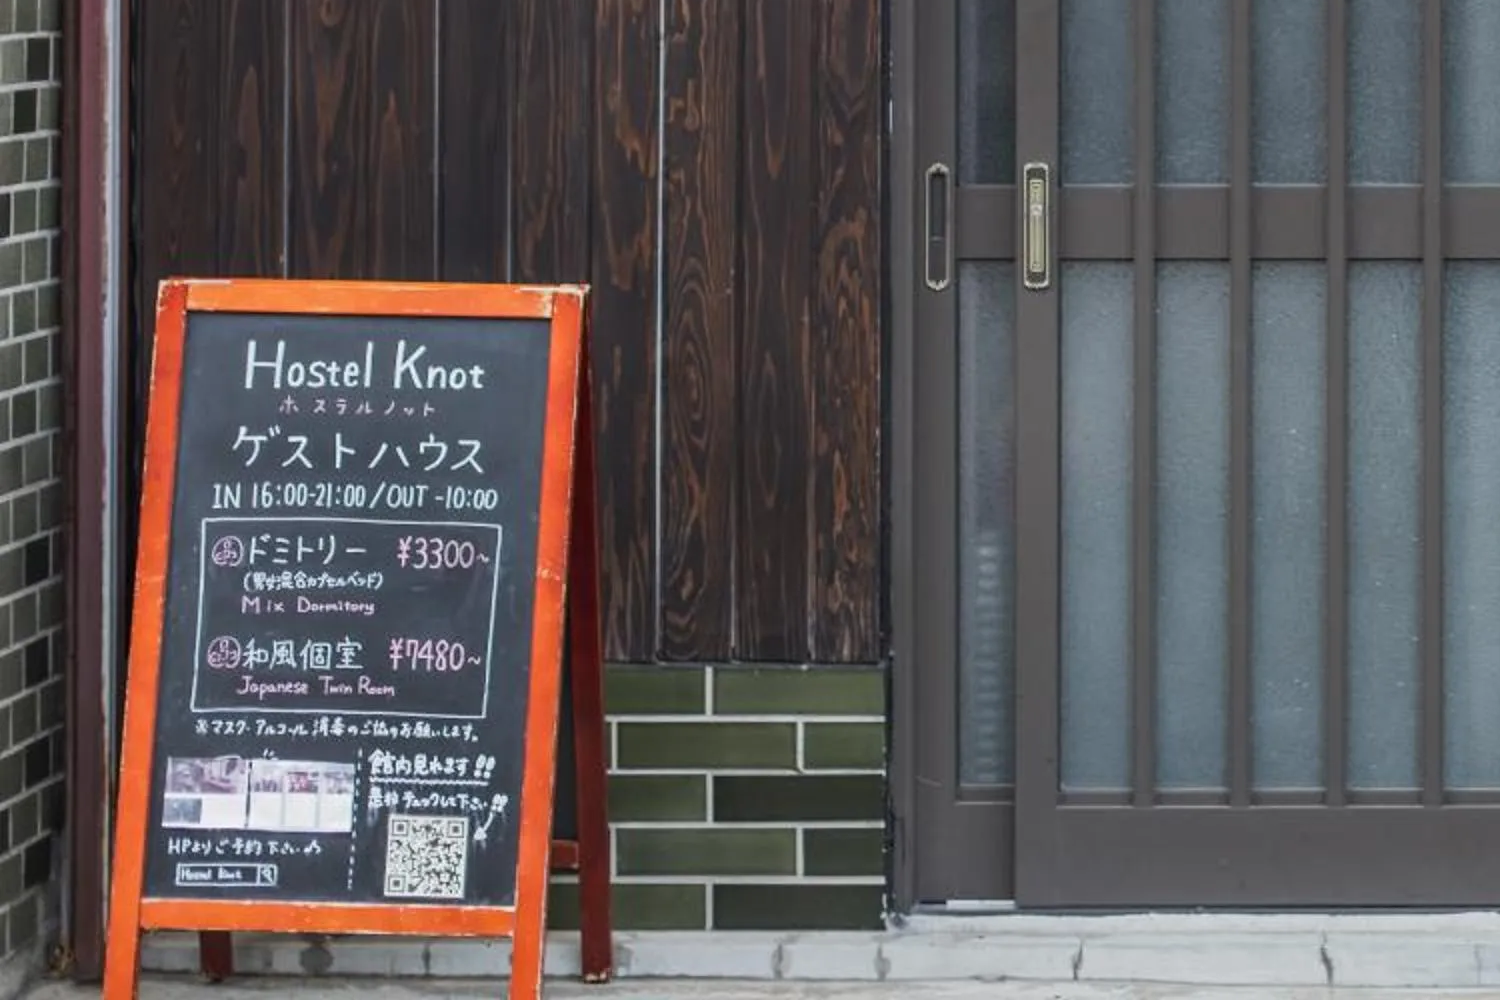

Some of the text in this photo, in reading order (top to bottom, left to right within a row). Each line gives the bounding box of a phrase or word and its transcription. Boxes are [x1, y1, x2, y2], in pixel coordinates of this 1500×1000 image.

[244, 340, 485, 389] Hostel Knot
[278, 396, 436, 418] ホステルノット
[231, 426, 485, 474] ゲストハウス
[212, 484, 240, 509] IN
[249, 534, 367, 565] ドミトリー
[241, 596, 375, 616] Mix Dormitory
[242, 636, 363, 671] 和風個室
[236, 676, 395, 698] Japanese Twin Room
